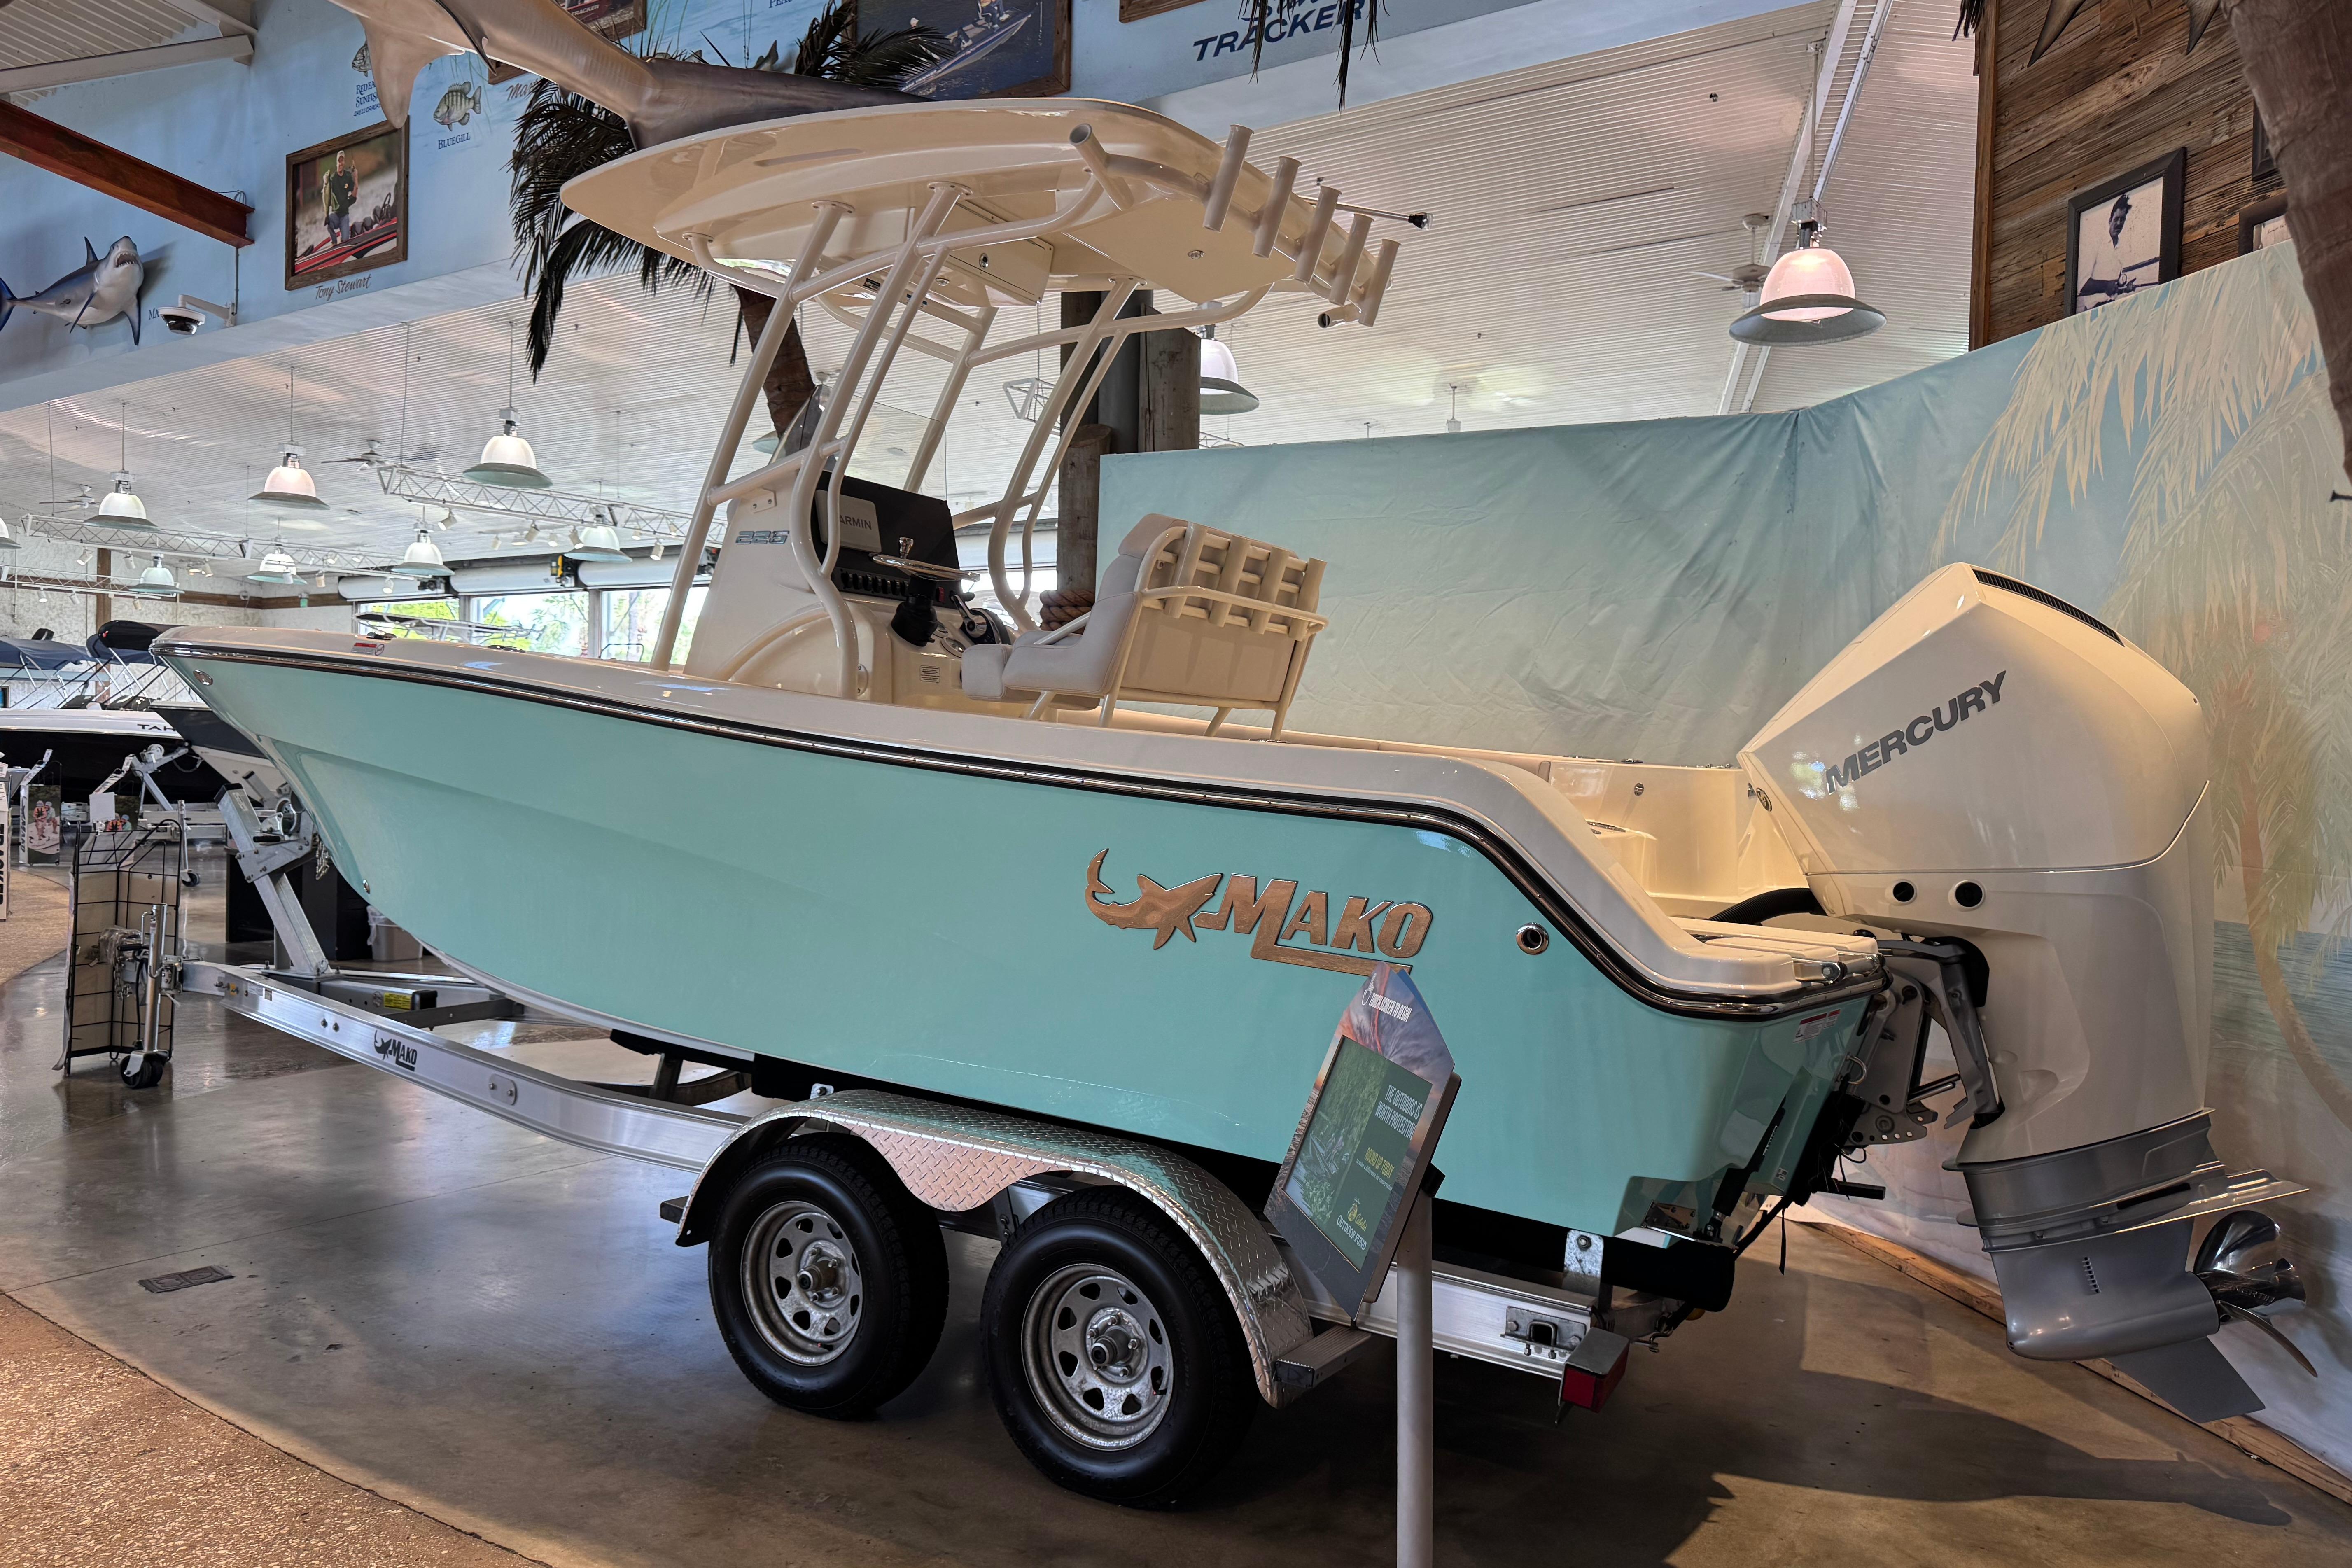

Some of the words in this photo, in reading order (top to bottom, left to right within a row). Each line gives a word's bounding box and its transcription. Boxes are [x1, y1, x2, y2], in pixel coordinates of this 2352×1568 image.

[1193, 0, 1365, 61] TRACKER
[438, 132, 471, 149] BLUEGILL
[315, 285, 335, 301] Tony
[336, 274, 372, 294] Stewart
[735, 530, 790, 544] 225
[840, 514, 872, 530] ARMIN
[1825, 670, 2006, 795] MERCURY
[1194, 873, 1433, 976] MAKO
[1369, 993, 1384, 1009] TOUCH
[1379, 997, 1396, 1015] SCREEN
[1392, 1002, 1401, 1018] TO
[1399, 1005, 1413, 1022] BEGIN
[388, 1039, 418, 1072] MAKO
[1375, 1101, 1393, 1123] WORTH
[1385, 1084, 1397, 1103] THE
[1392, 1090, 1418, 1117] OUTDOORS
[1414, 1103, 1423, 1120] IS
[1364, 1147, 1379, 1166] ROUND
[1375, 1155, 1384, 1169] UP
[1381, 1159, 1395, 1179] TODAY
[1337, 1215, 1356, 1241] OUTDOOR
[1354, 1233, 1367, 1250] FUND
